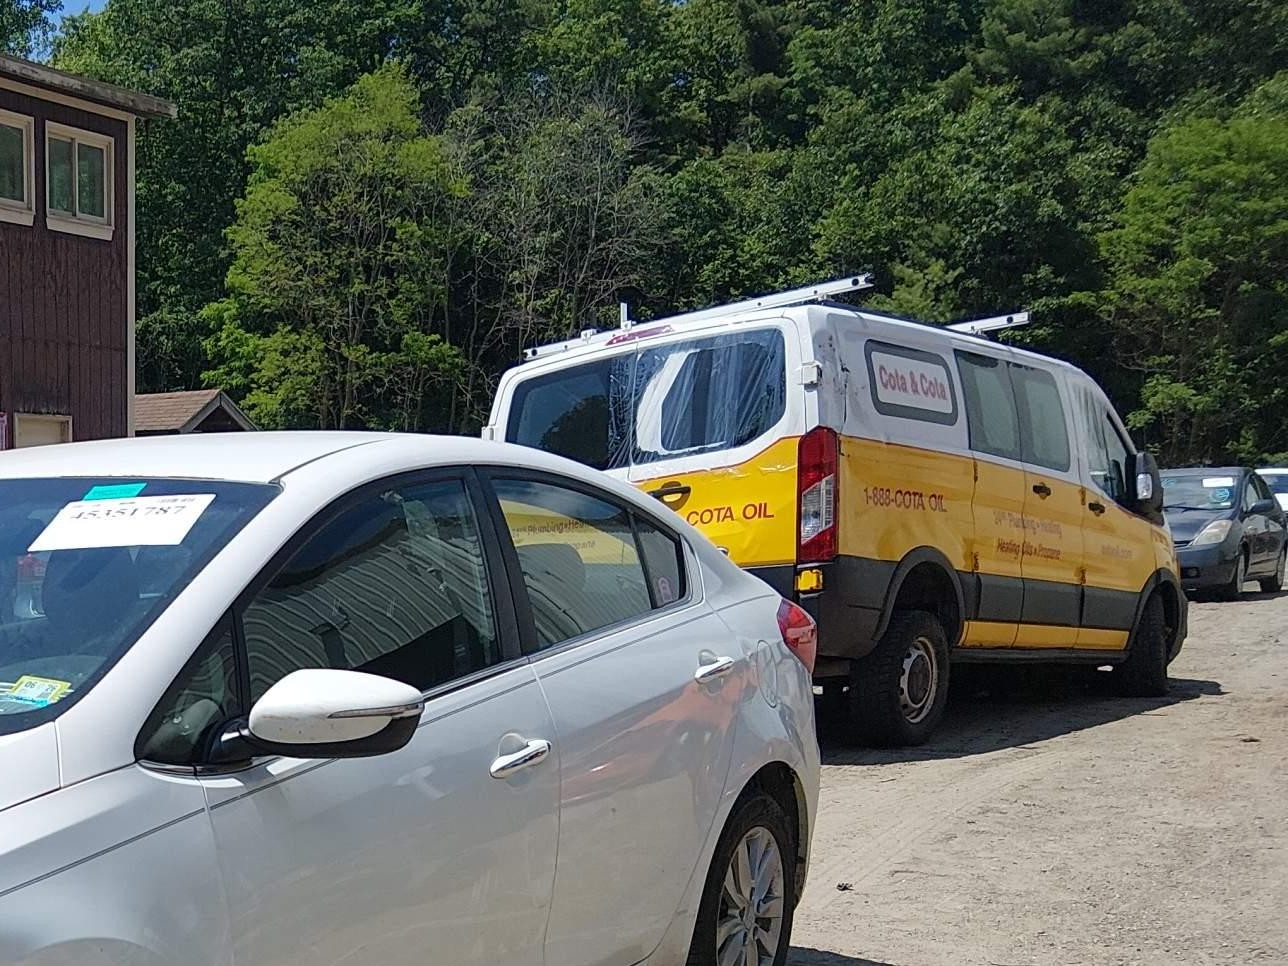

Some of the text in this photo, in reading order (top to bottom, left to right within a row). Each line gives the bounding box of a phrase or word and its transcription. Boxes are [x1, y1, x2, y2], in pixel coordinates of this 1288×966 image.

[909, 370, 920, 396] &
[864, 487, 948, 513] 1-888-COTA OIL
[686, 502, 775, 526] COTA OIL
